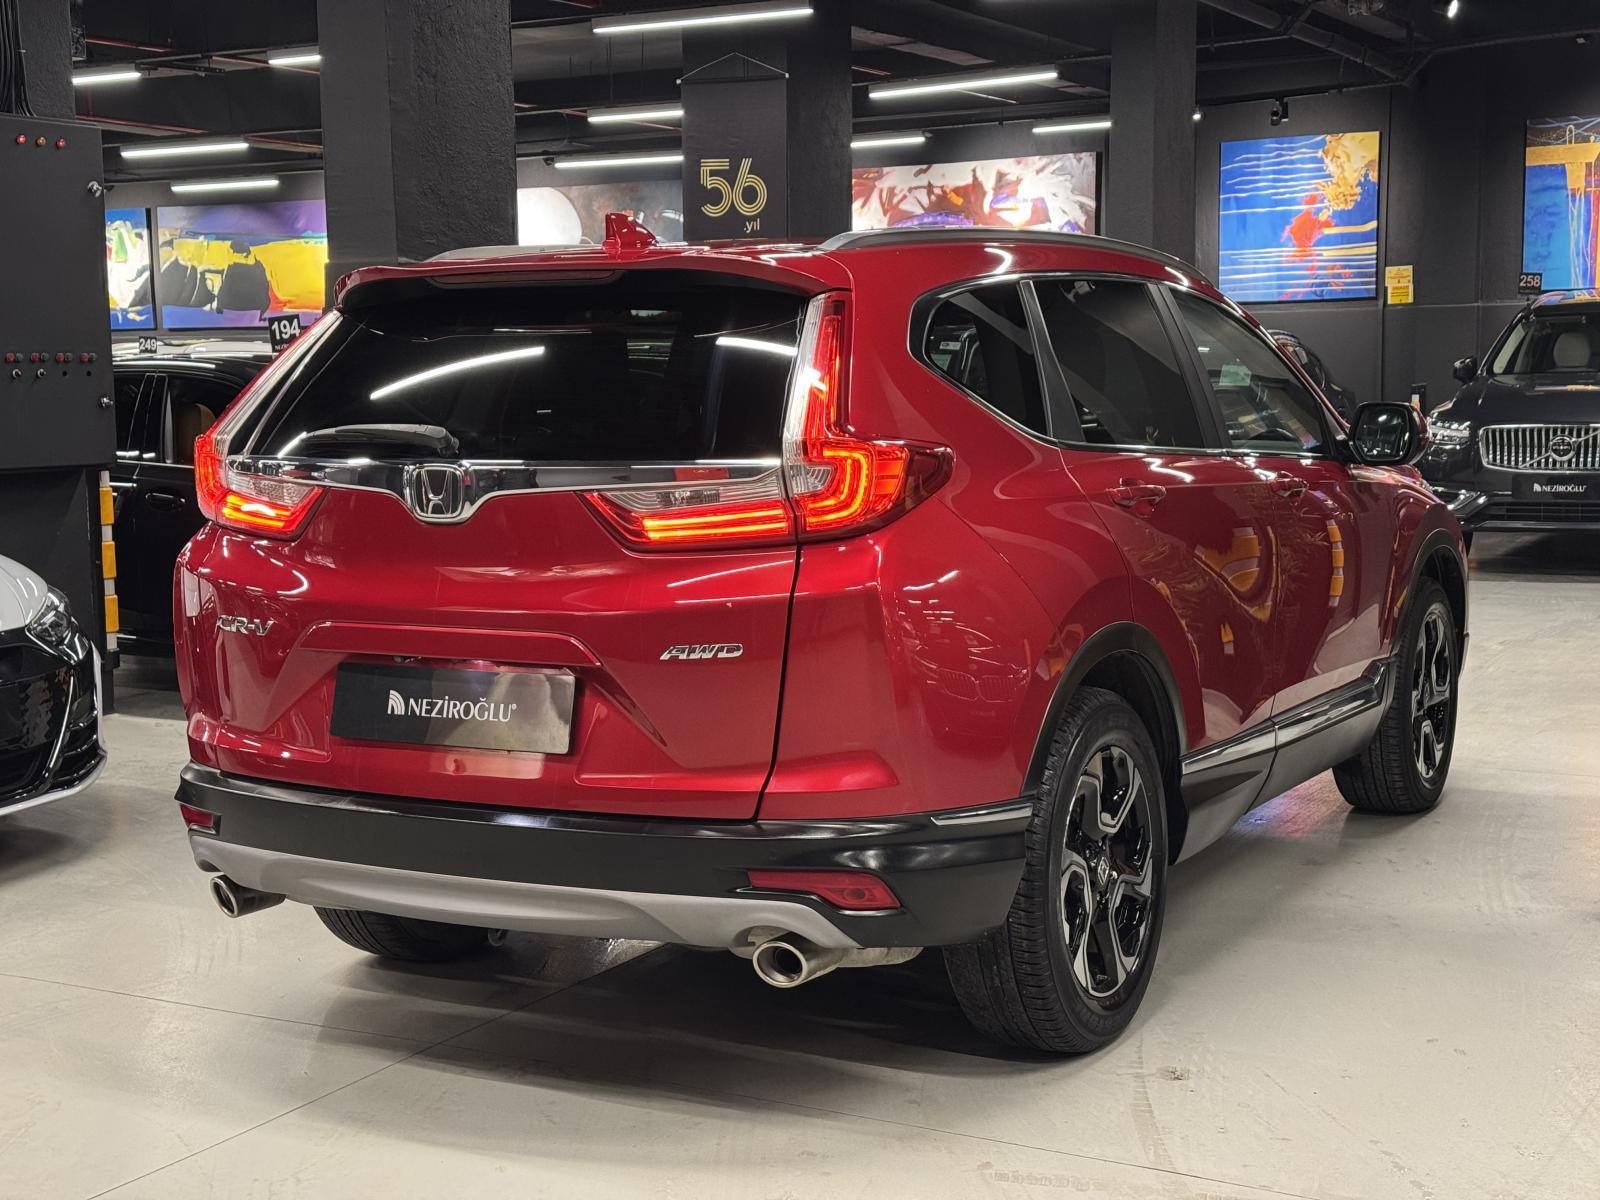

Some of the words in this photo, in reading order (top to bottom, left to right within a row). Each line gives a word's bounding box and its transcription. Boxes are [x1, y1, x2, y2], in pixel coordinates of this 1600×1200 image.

[700, 158, 767, 217] 56
[1519, 274, 1541, 287] 258
[271, 318, 300, 340] 194
[139, 338, 157, 350] 249
[217, 614, 275, 636] CR-V
[659, 643, 743, 661] AWD
